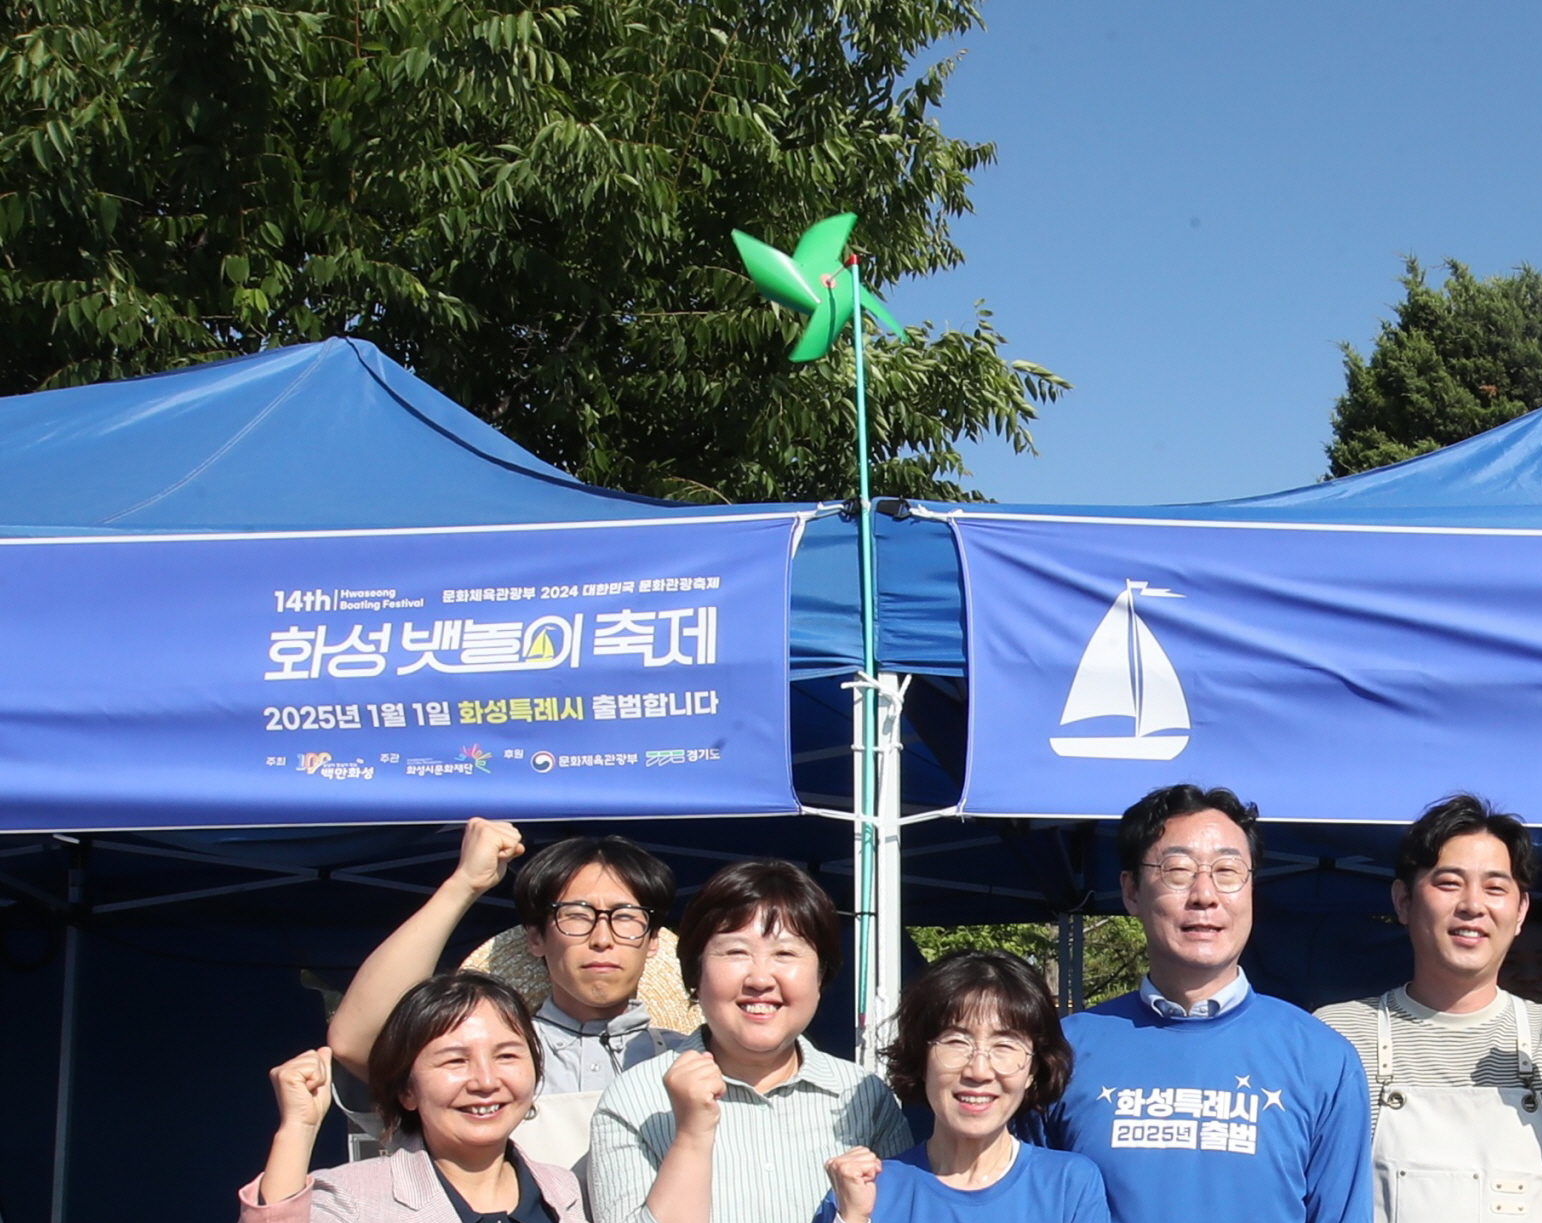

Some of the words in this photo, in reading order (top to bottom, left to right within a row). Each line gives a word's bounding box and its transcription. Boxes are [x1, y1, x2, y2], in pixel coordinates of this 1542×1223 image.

[340, 589, 396, 600] Hwaseong
[442, 586, 536, 603] 문화체육관광부
[540, 585, 580, 599] 2024
[582, 581, 635, 597] 대한민국
[638, 576, 720, 592] 문화관광축제
[274, 589, 331, 612] 14th
[340, 599, 380, 611] Boating
[382, 598, 424, 608] Festival
[264, 622, 392, 680] 화성
[396, 613, 584, 676] 뱃놀이
[593, 606, 717, 667] 축제
[263, 704, 362, 731] 2025년
[367, 702, 407, 728] 1월
[412, 701, 452, 726] 1일
[457, 697, 585, 724] 화성특례시
[592, 690, 719, 720] 출범합니다
[266, 756, 287, 767] 주최
[380, 753, 400, 764] 주관
[558, 753, 639, 768] 문화체육관광부
[686, 748, 721, 762] 경기도
[1114, 1087, 1259, 1123] 화성특례시
[1117, 1124, 1192, 1143] 2025년
[1200, 1120, 1258, 1155] 출범
